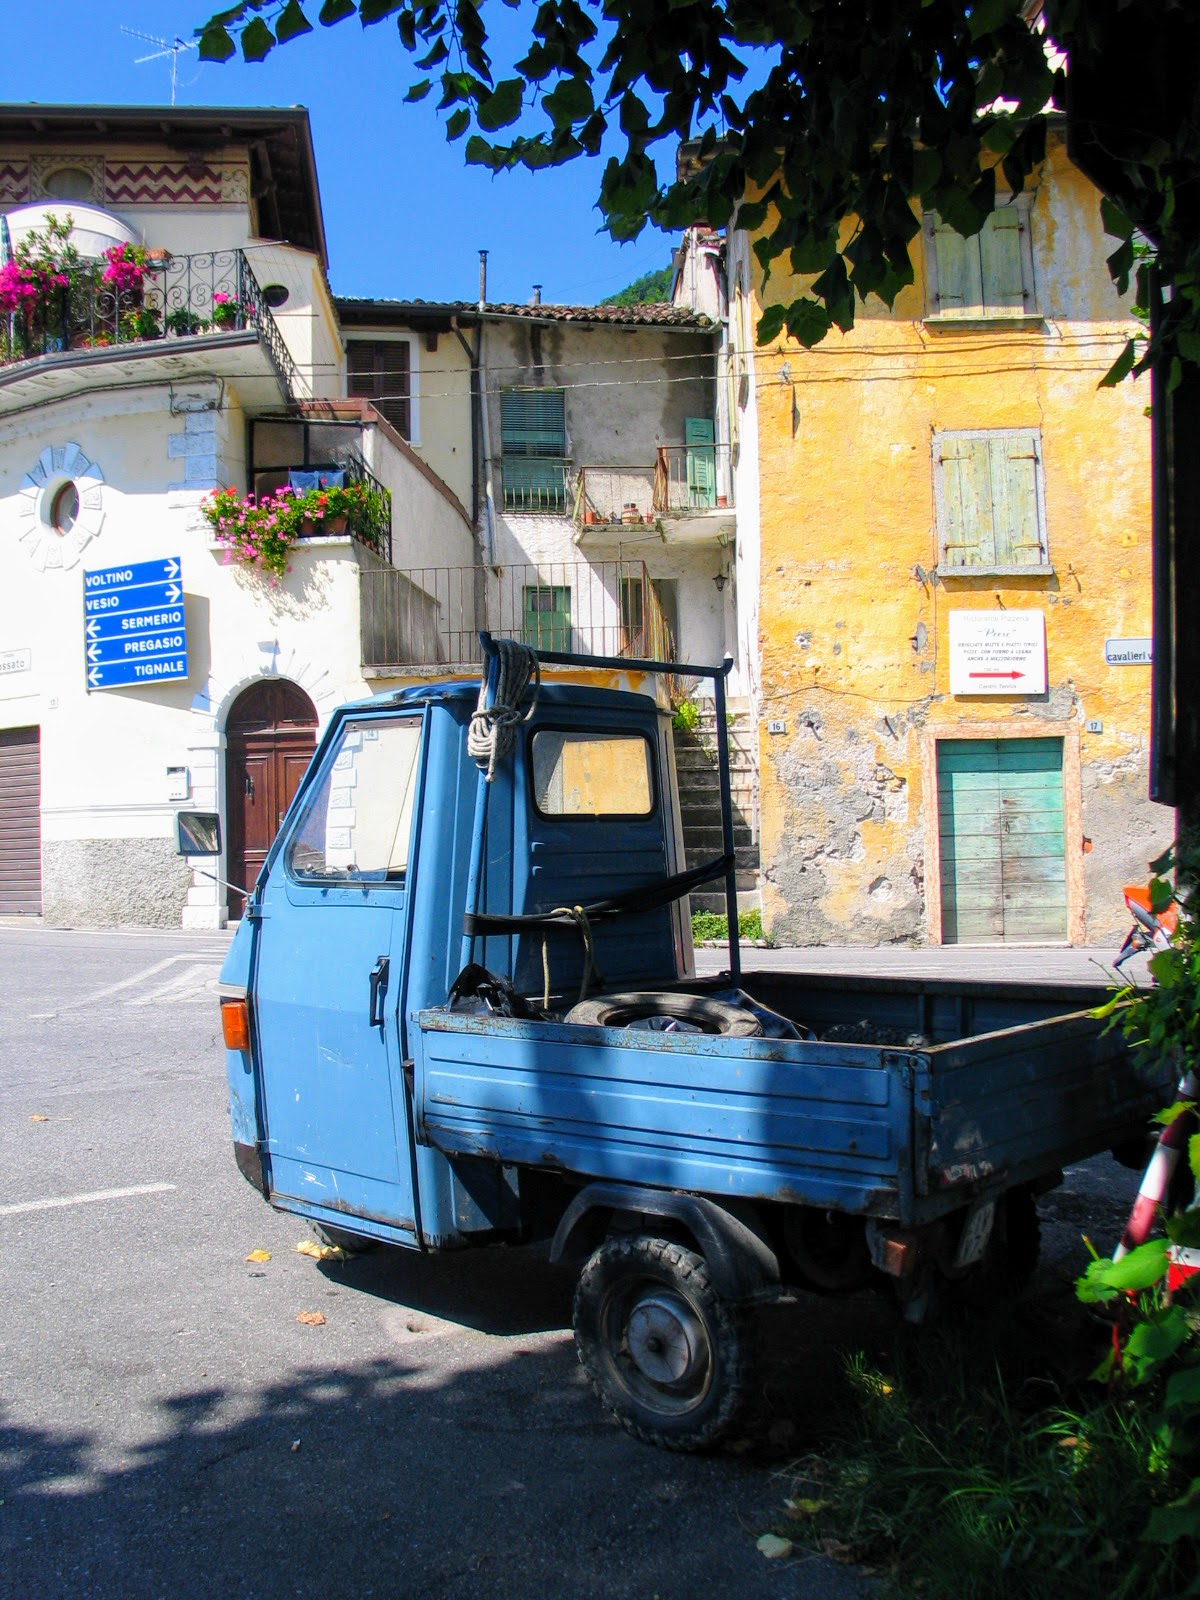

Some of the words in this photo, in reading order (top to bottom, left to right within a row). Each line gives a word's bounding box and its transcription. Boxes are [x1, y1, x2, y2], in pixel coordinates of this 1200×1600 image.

[85, 570, 133, 587] VOLTINO
[86, 596, 119, 611] VESIO
[121, 611, 181, 630] SERMERIO
[124, 636, 183, 654] PREGASIO
[1107, 651, 1146, 661] cavalieri
[134, 660, 185, 677] TIGNALE
[772, 722, 781, 731] 16
[1090, 722, 1098, 730] 17
